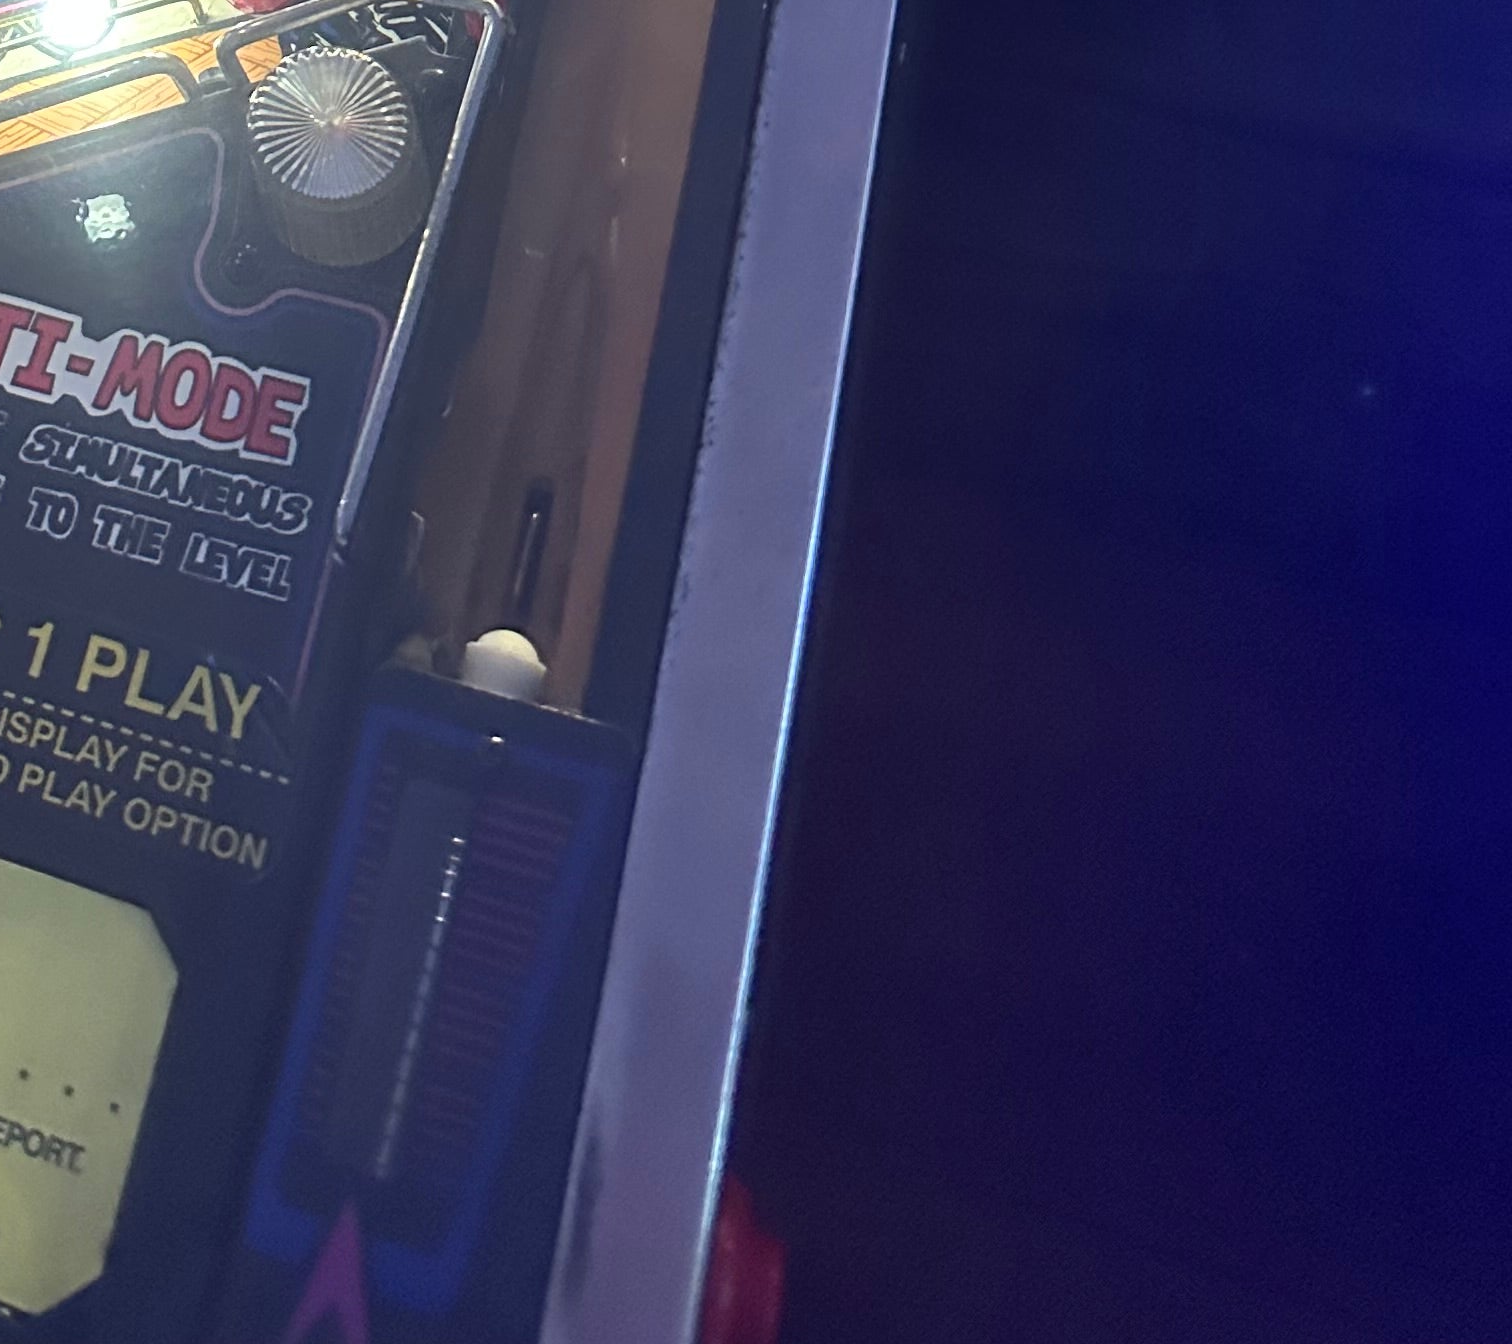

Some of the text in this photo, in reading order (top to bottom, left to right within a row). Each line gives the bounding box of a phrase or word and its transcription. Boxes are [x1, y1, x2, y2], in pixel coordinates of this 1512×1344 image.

[18, 423, 312, 536] SIMULTANEOUS
[25, 486, 80, 540] TO
[91, 504, 171, 564] THE
[179, 532, 292, 602] LEVEL
[25, 621, 55, 679] 1
[74, 633, 263, 740] PLAY
[17, 761, 117, 820] PLAY
[122, 797, 269, 870] OPTION
[133, 750, 216, 803] FOR
